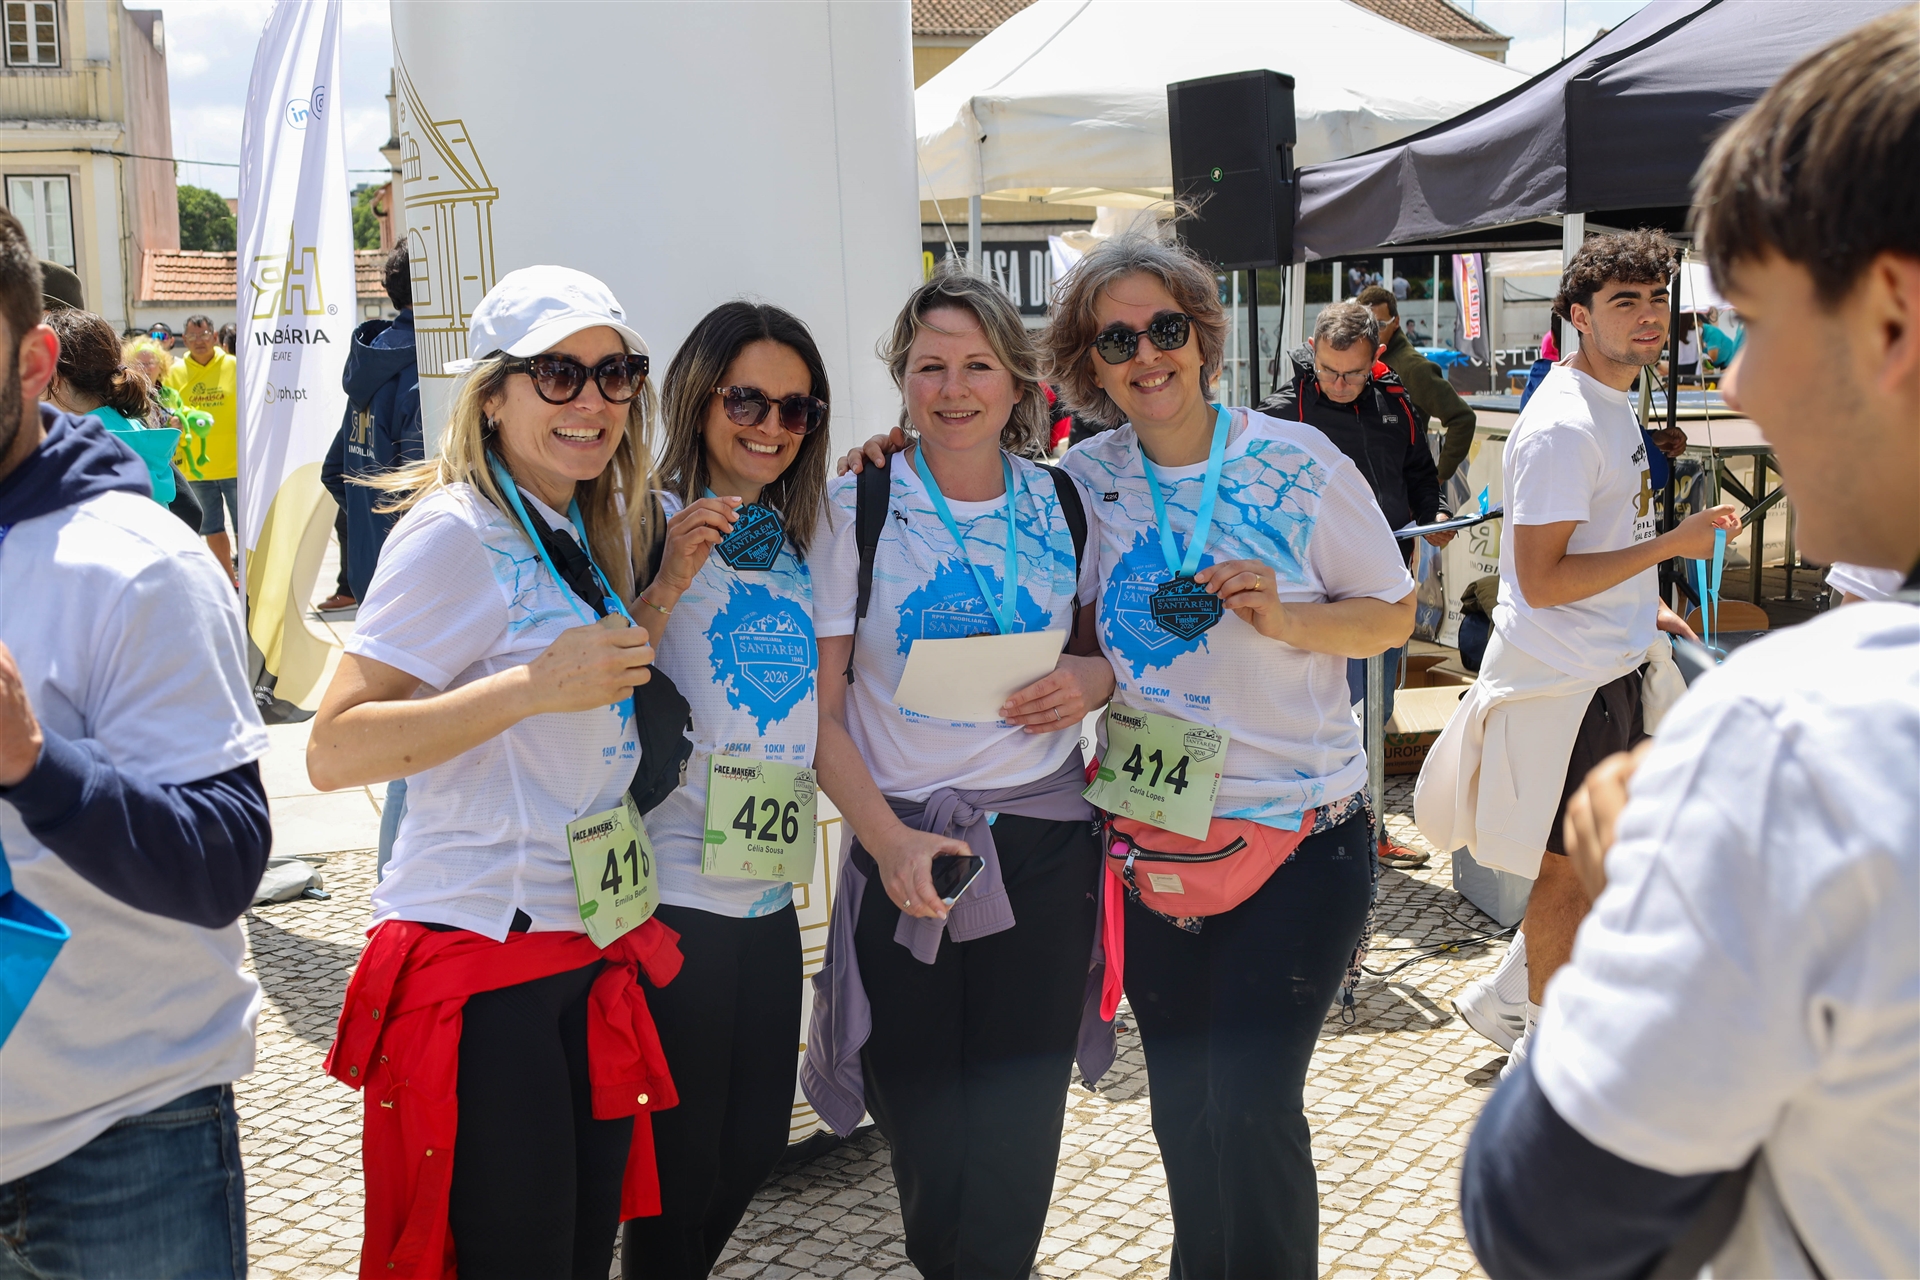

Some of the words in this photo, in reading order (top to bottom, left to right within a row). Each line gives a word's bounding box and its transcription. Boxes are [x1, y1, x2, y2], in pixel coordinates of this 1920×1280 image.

[726, 522, 774, 554] SANTARÉM
[1158, 599, 1213, 610] SANTARÉM
[1175, 614, 1199, 624] Finisher
[740, 642, 804, 656] SANTARÉM
[763, 670, 788, 683] 2026
[1140, 686, 1170, 697] 10KM
[1184, 693, 1211, 704] 10KM
[724, 743, 751, 752] 18KM
[764, 744, 785, 753] 10KM
[792, 744, 806, 753] 10KM
[1384, 745, 1430, 759] UROPE
[1122, 744, 1189, 795] 414
[1130, 786, 1145, 797] Carla
[1146, 790, 1165, 802] Lopes
[732, 795, 799, 844] 426
[747, 843, 763, 852] Célia
[765, 846, 783, 855] Sousa
